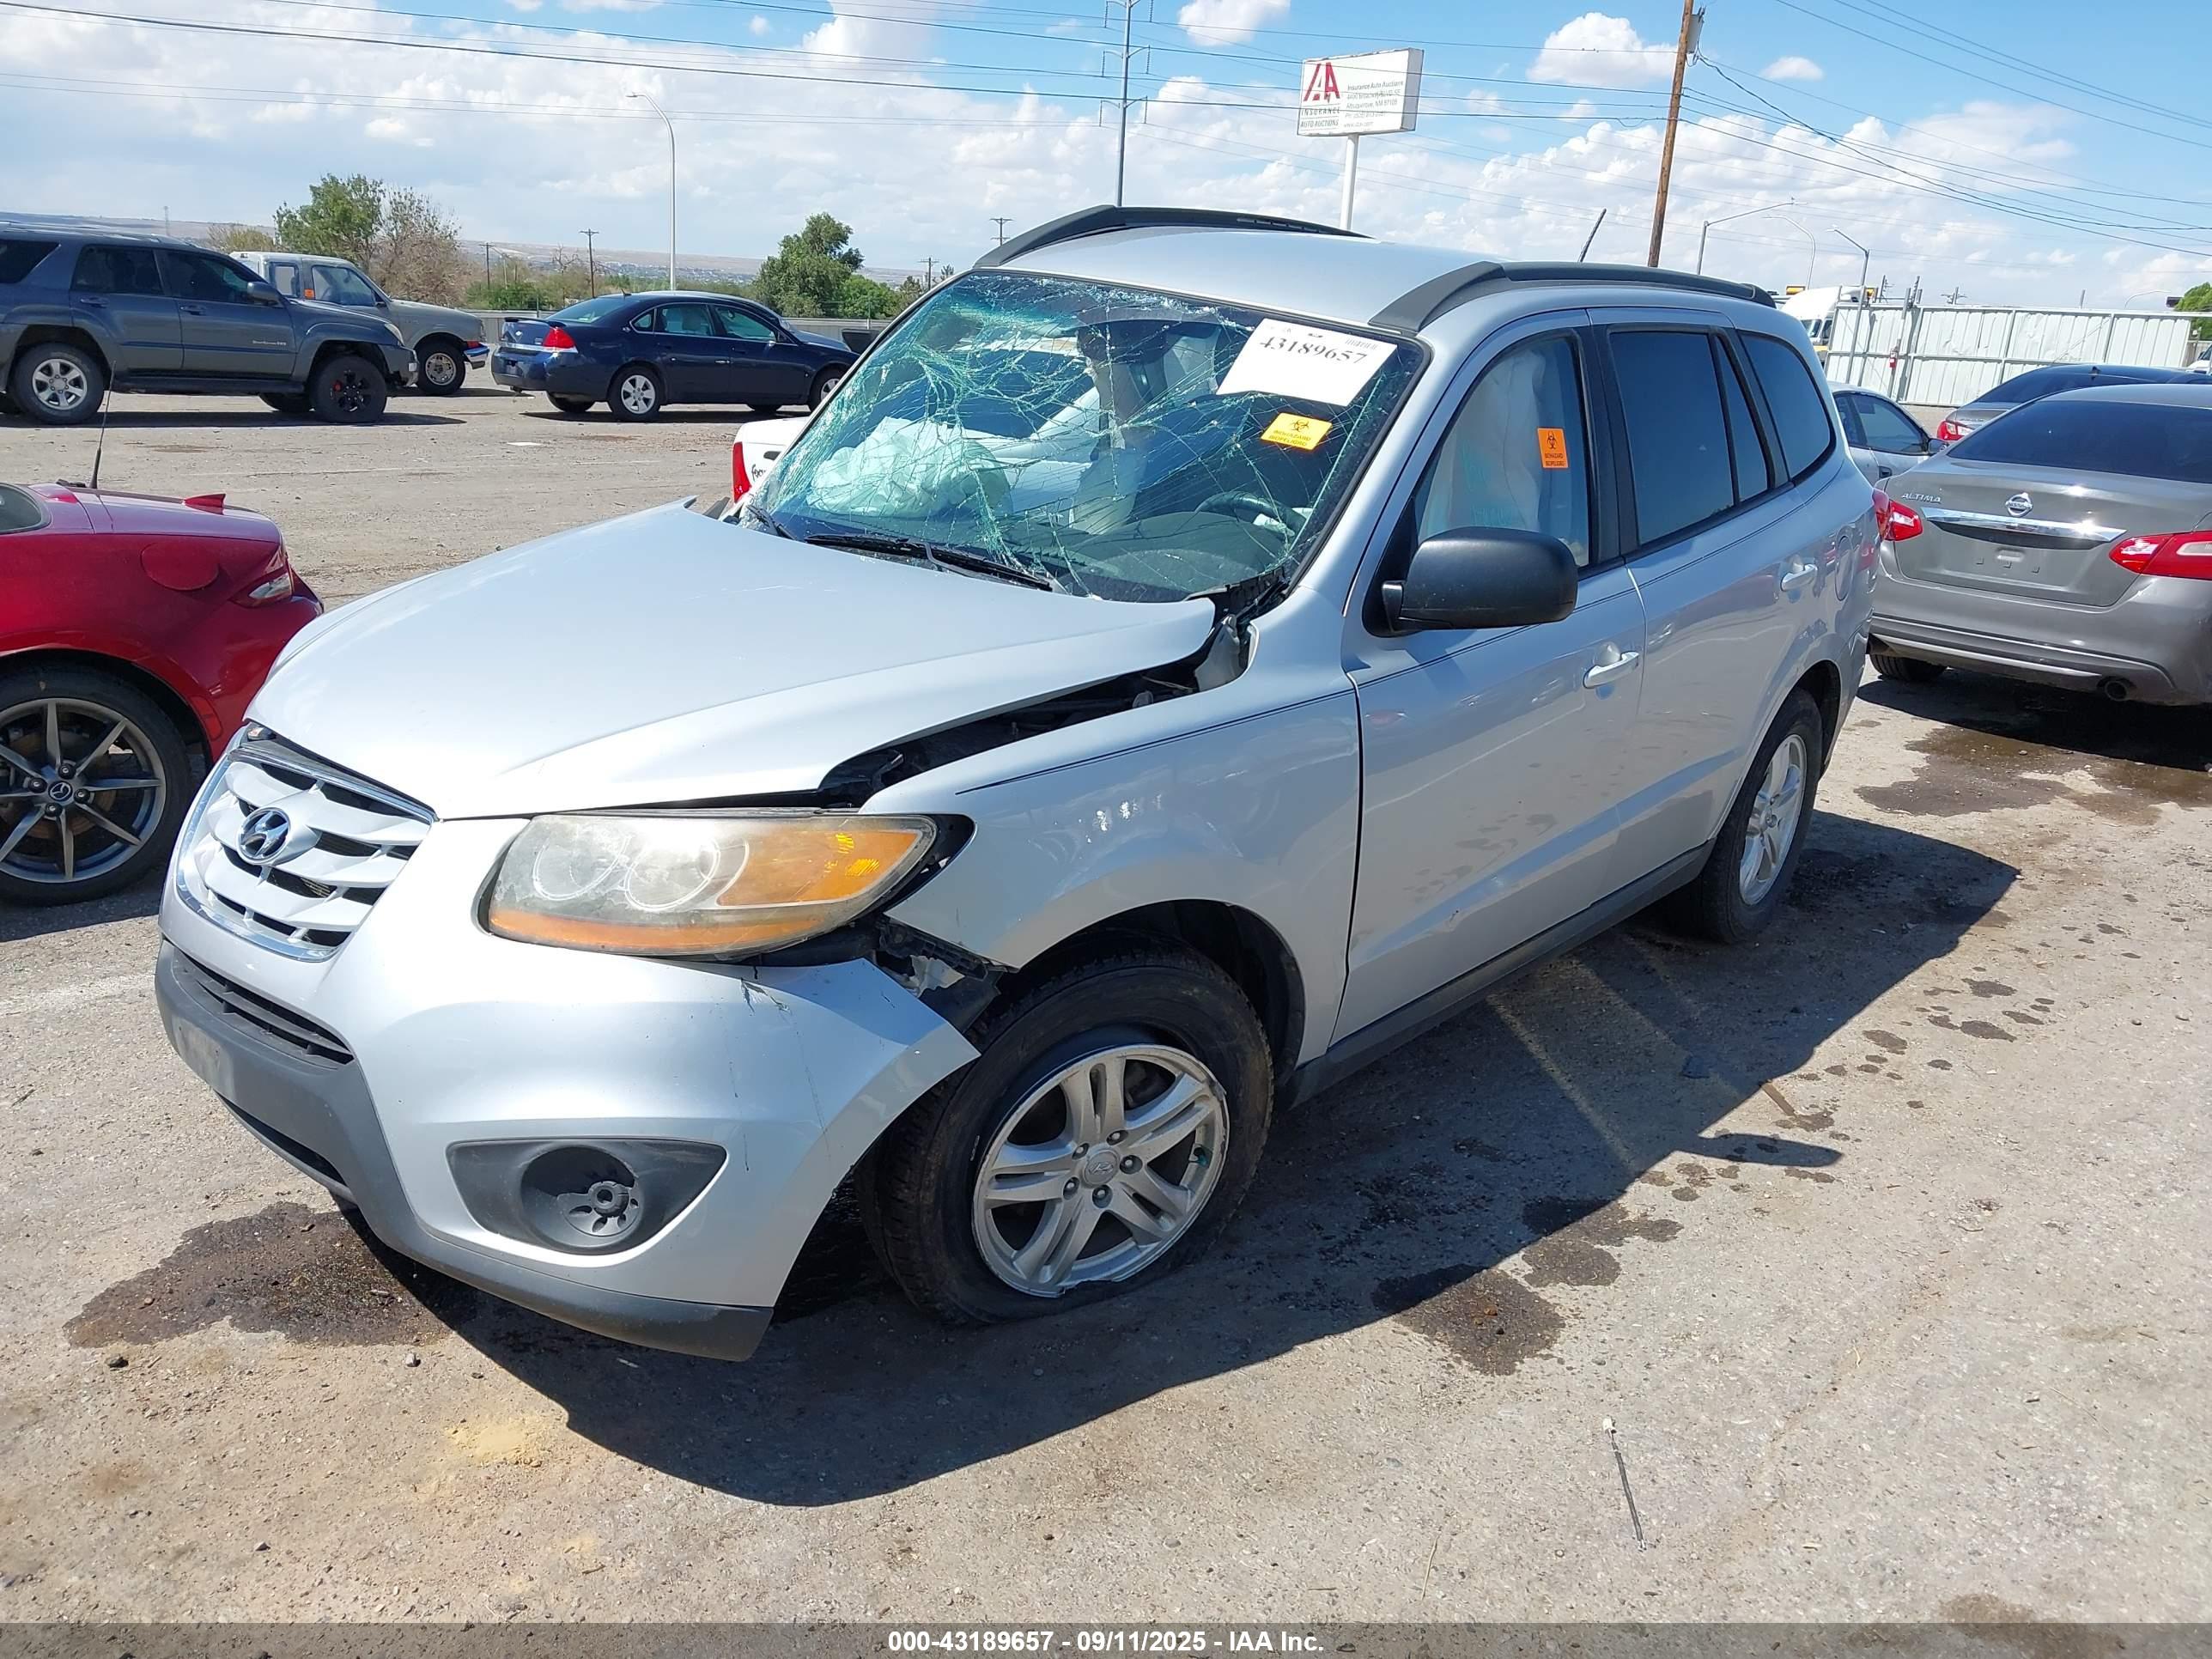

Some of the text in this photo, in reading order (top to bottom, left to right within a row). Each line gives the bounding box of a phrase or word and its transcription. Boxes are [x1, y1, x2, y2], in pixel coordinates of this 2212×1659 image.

[1301, 107, 1340, 116] INSURANCE
[1260, 336, 1368, 364] 43189657
[1901, 493, 1942, 504] ALTIMA
